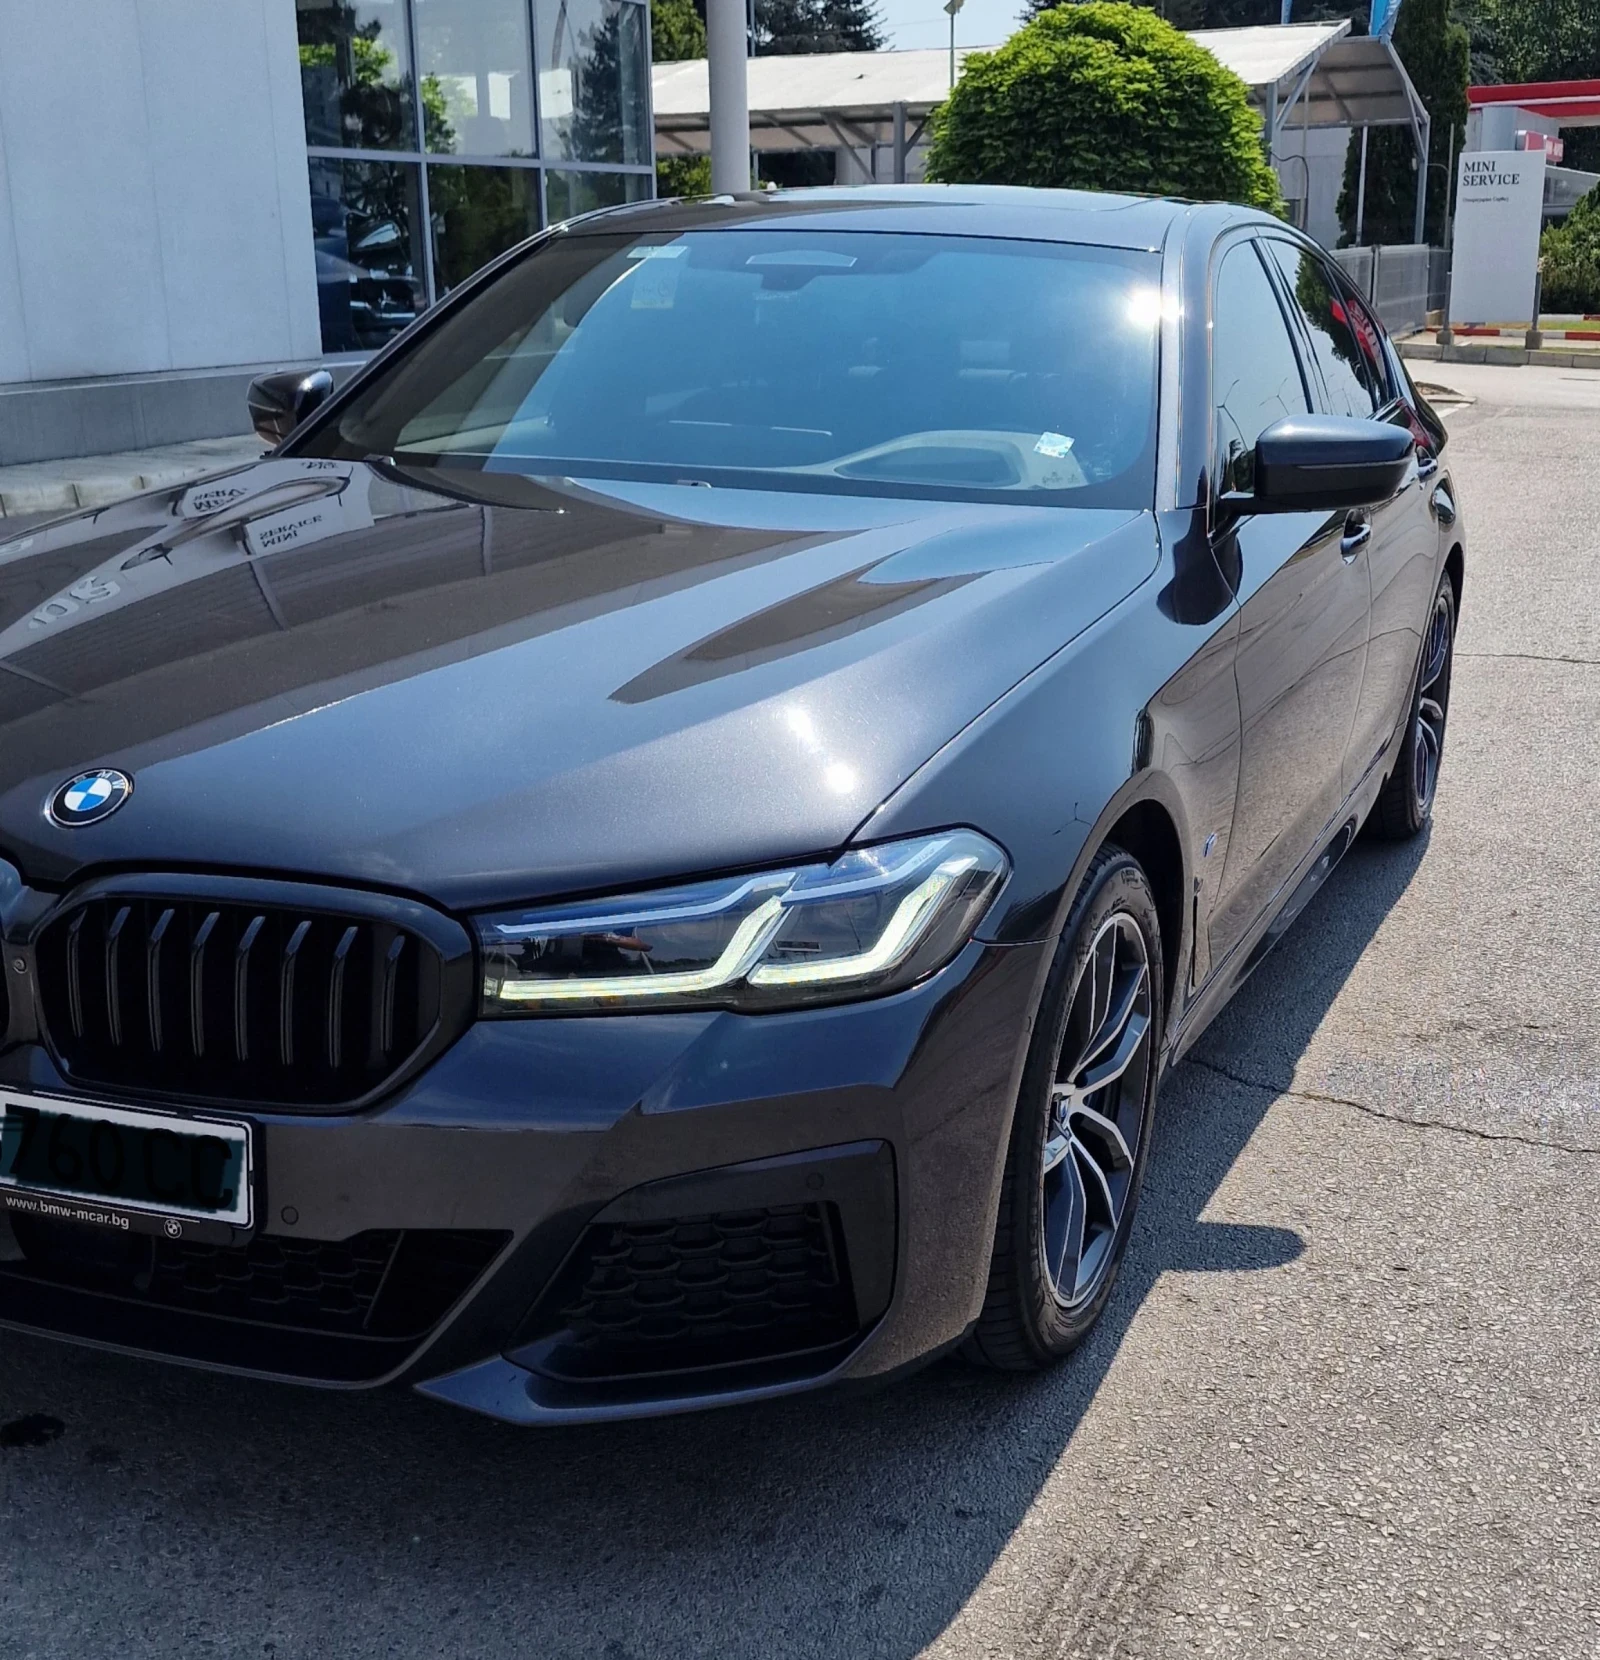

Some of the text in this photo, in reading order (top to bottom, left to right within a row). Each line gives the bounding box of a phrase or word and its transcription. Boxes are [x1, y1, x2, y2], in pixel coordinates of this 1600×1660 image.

[1464, 160, 1496, 172] MINI
[1462, 173, 1520, 186] SERVICE
[0, 1103, 125, 1191] 760
[5, 1196, 130, 1230] www.bmw-mcar.bg
